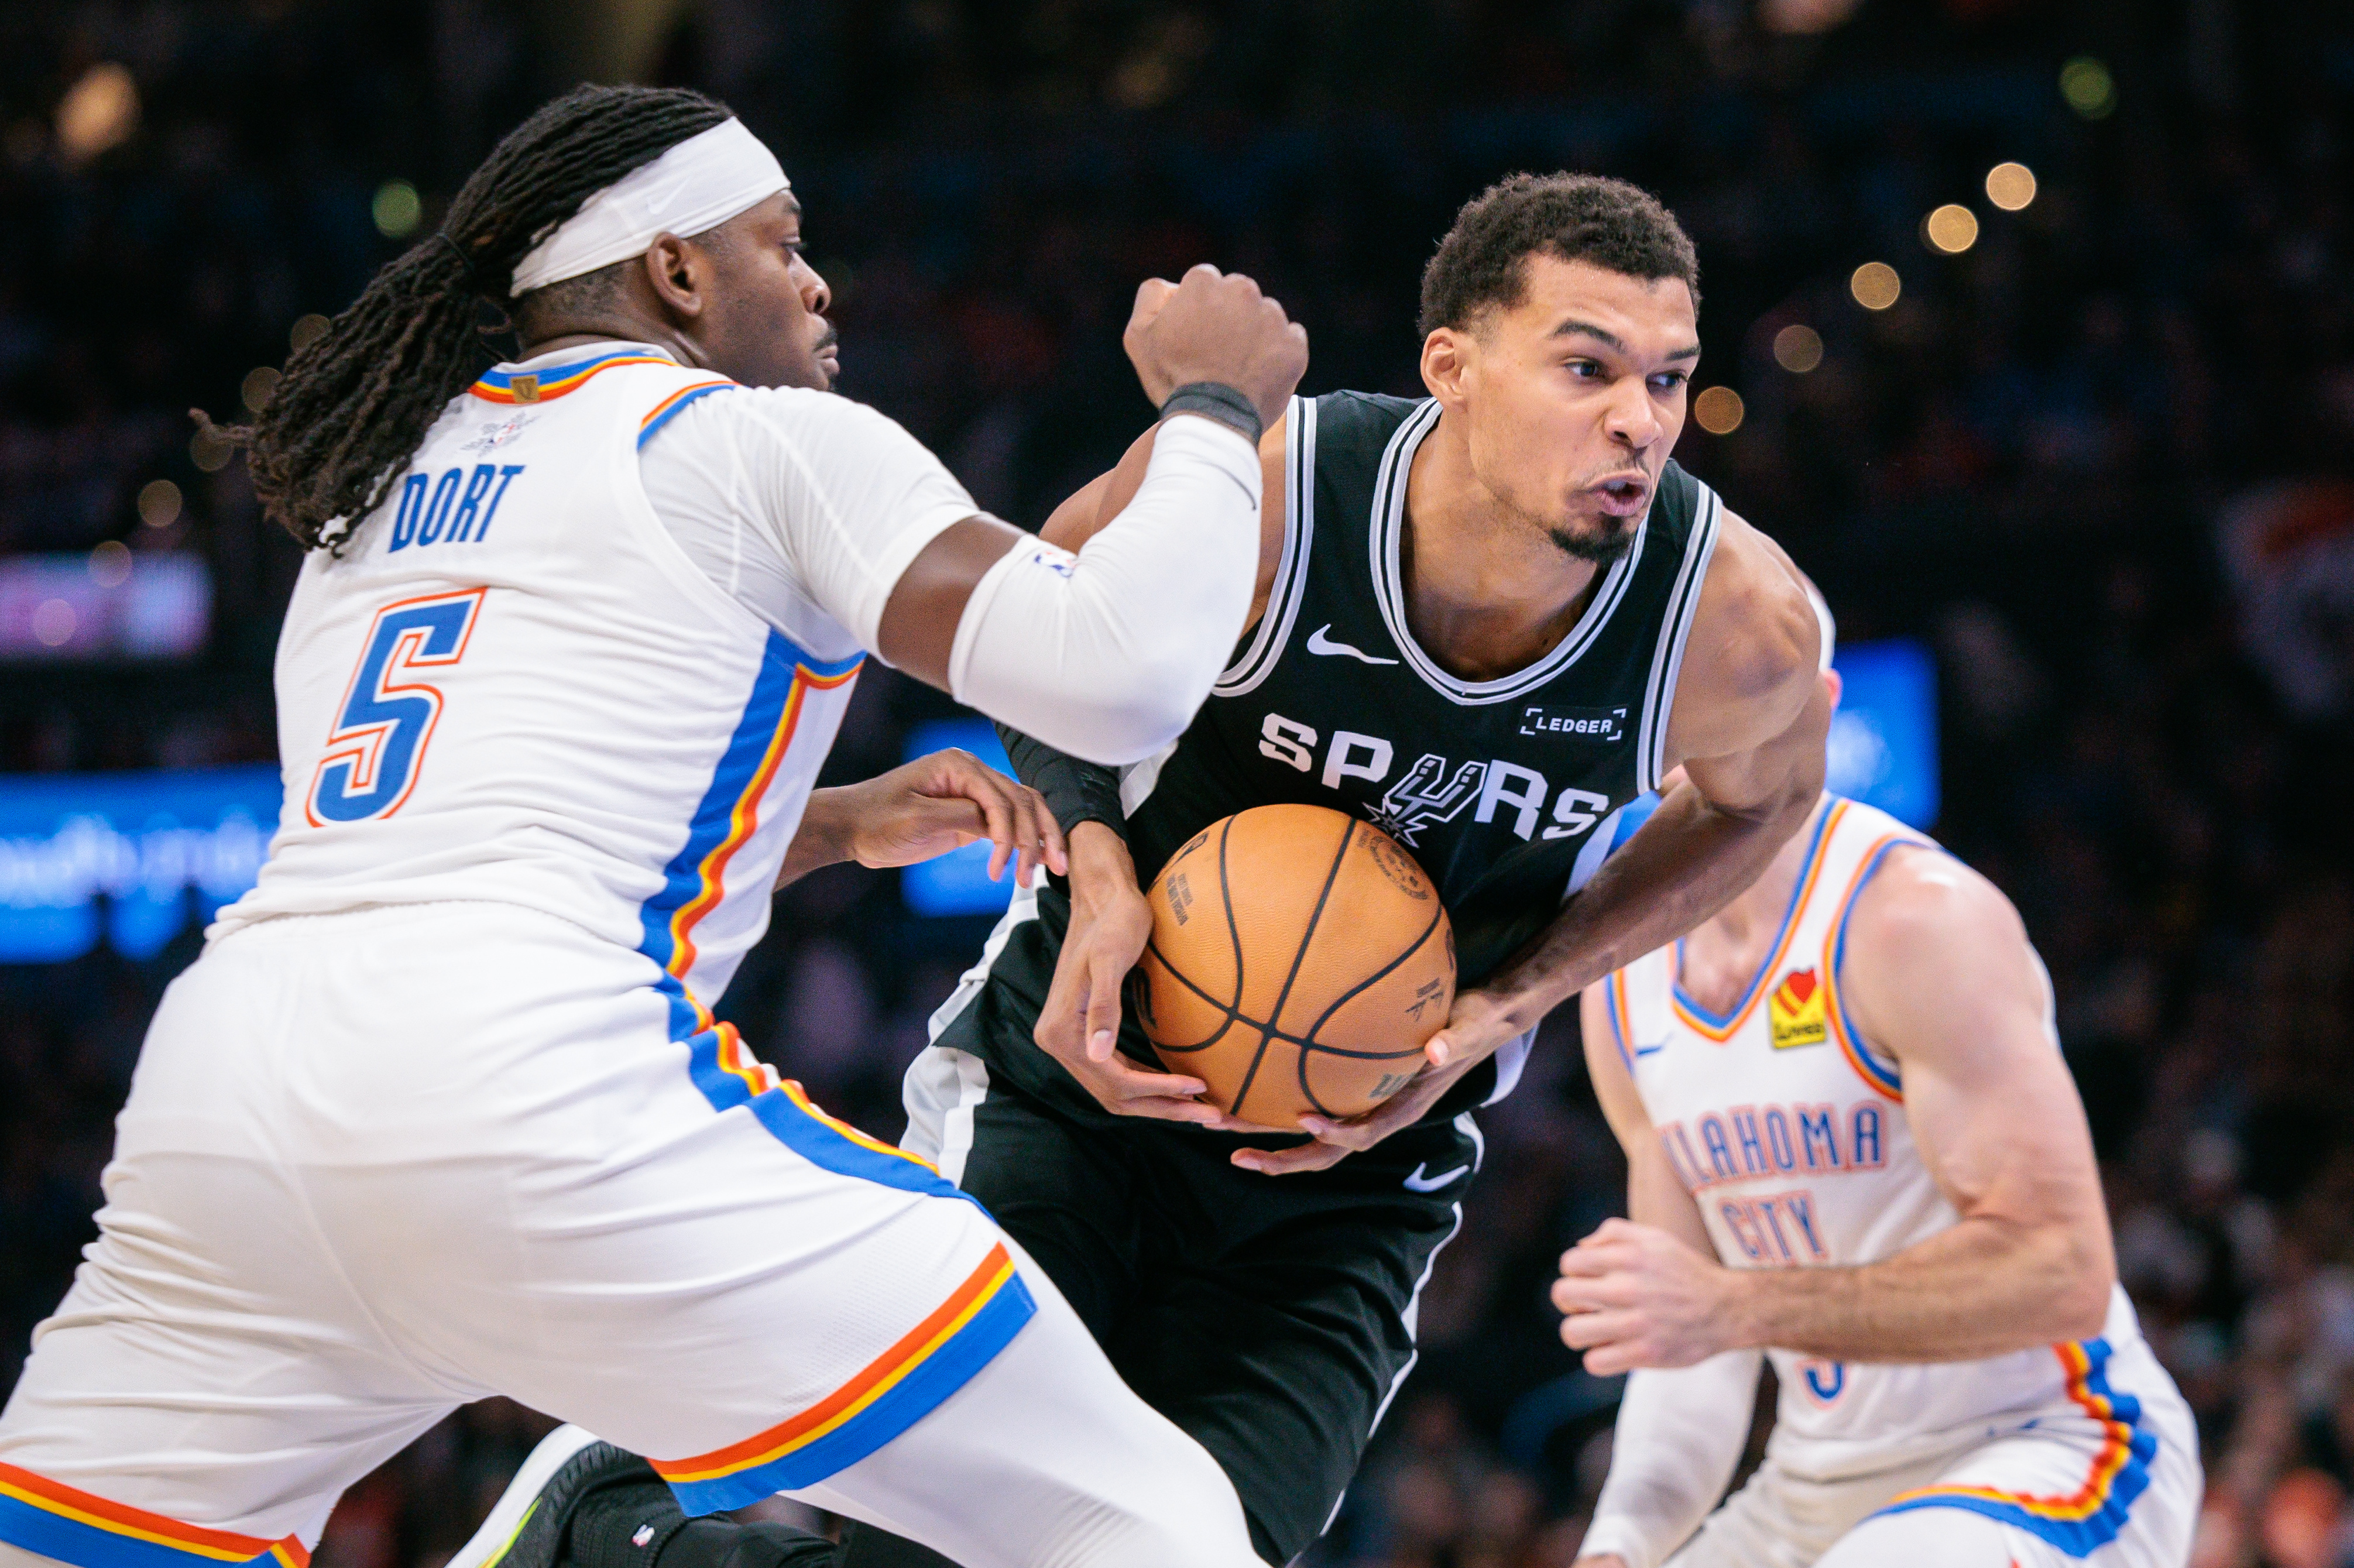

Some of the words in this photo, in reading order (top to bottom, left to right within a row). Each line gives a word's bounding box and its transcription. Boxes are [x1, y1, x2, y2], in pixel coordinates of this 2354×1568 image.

[387, 464, 526, 553] DORT
[305, 586, 488, 828] 5
[1535, 716, 1612, 733] LEDGER
[1258, 712, 1610, 848] SPURS
[1655, 1100, 1888, 1195] LAHOMA
[1717, 1189, 1828, 1268] CITY
